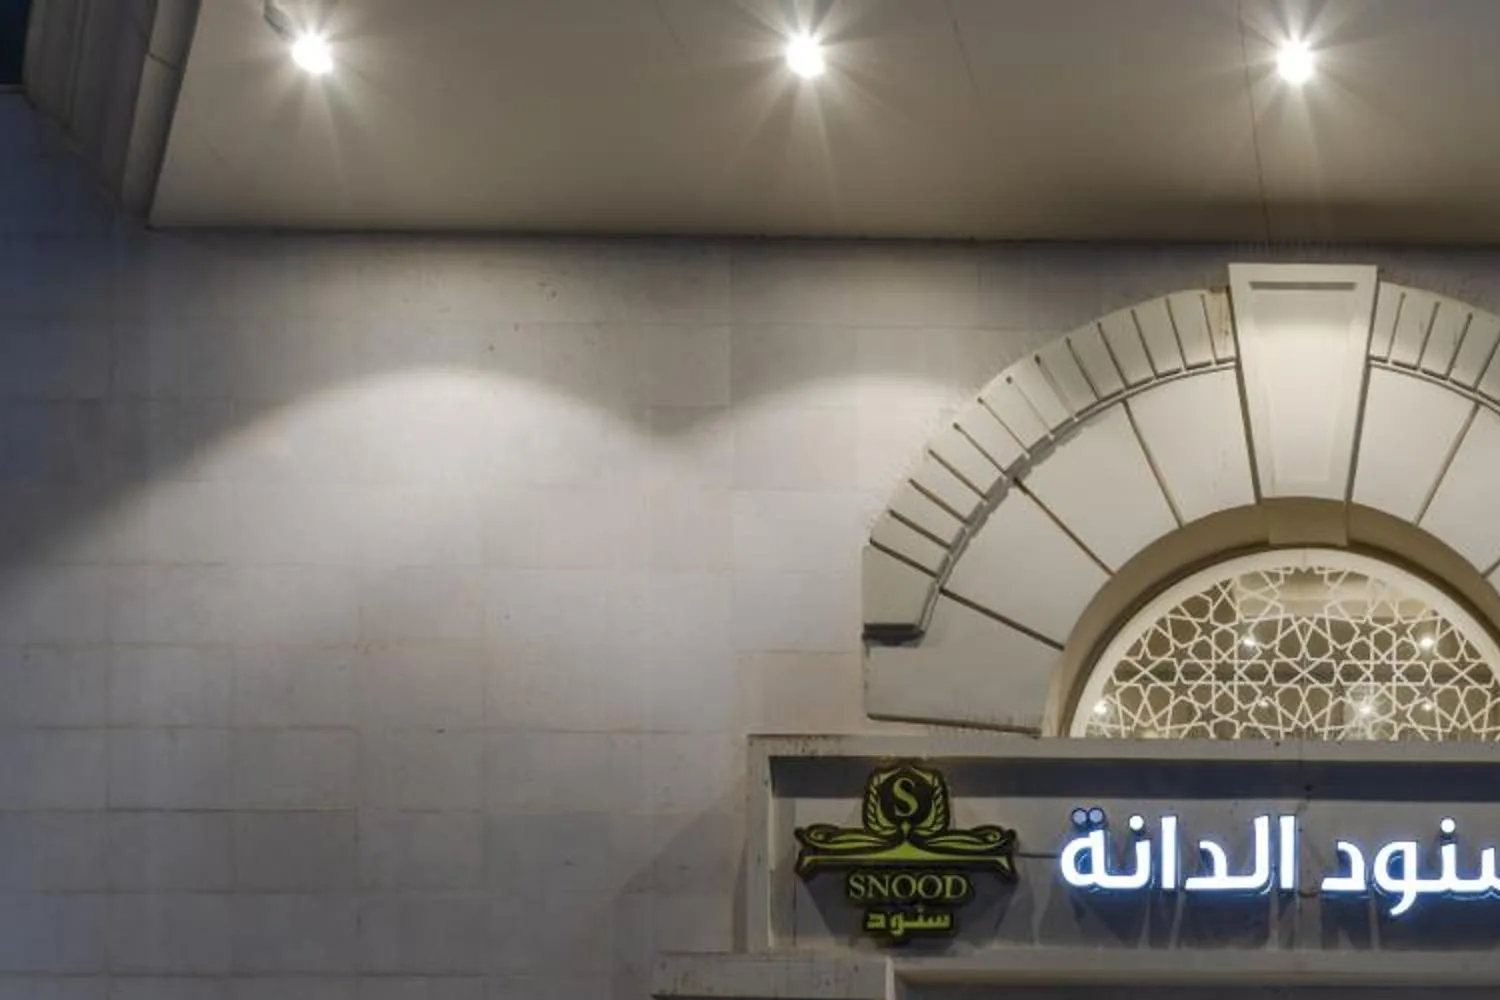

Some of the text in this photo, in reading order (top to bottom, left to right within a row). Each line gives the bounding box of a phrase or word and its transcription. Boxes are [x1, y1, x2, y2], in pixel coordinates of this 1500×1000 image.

[892, 777, 918, 817] S
[1059, 807, 1297, 893] الدانة
[849, 874, 968, 899] SNOOD
[866, 904, 951, 936] سنود
